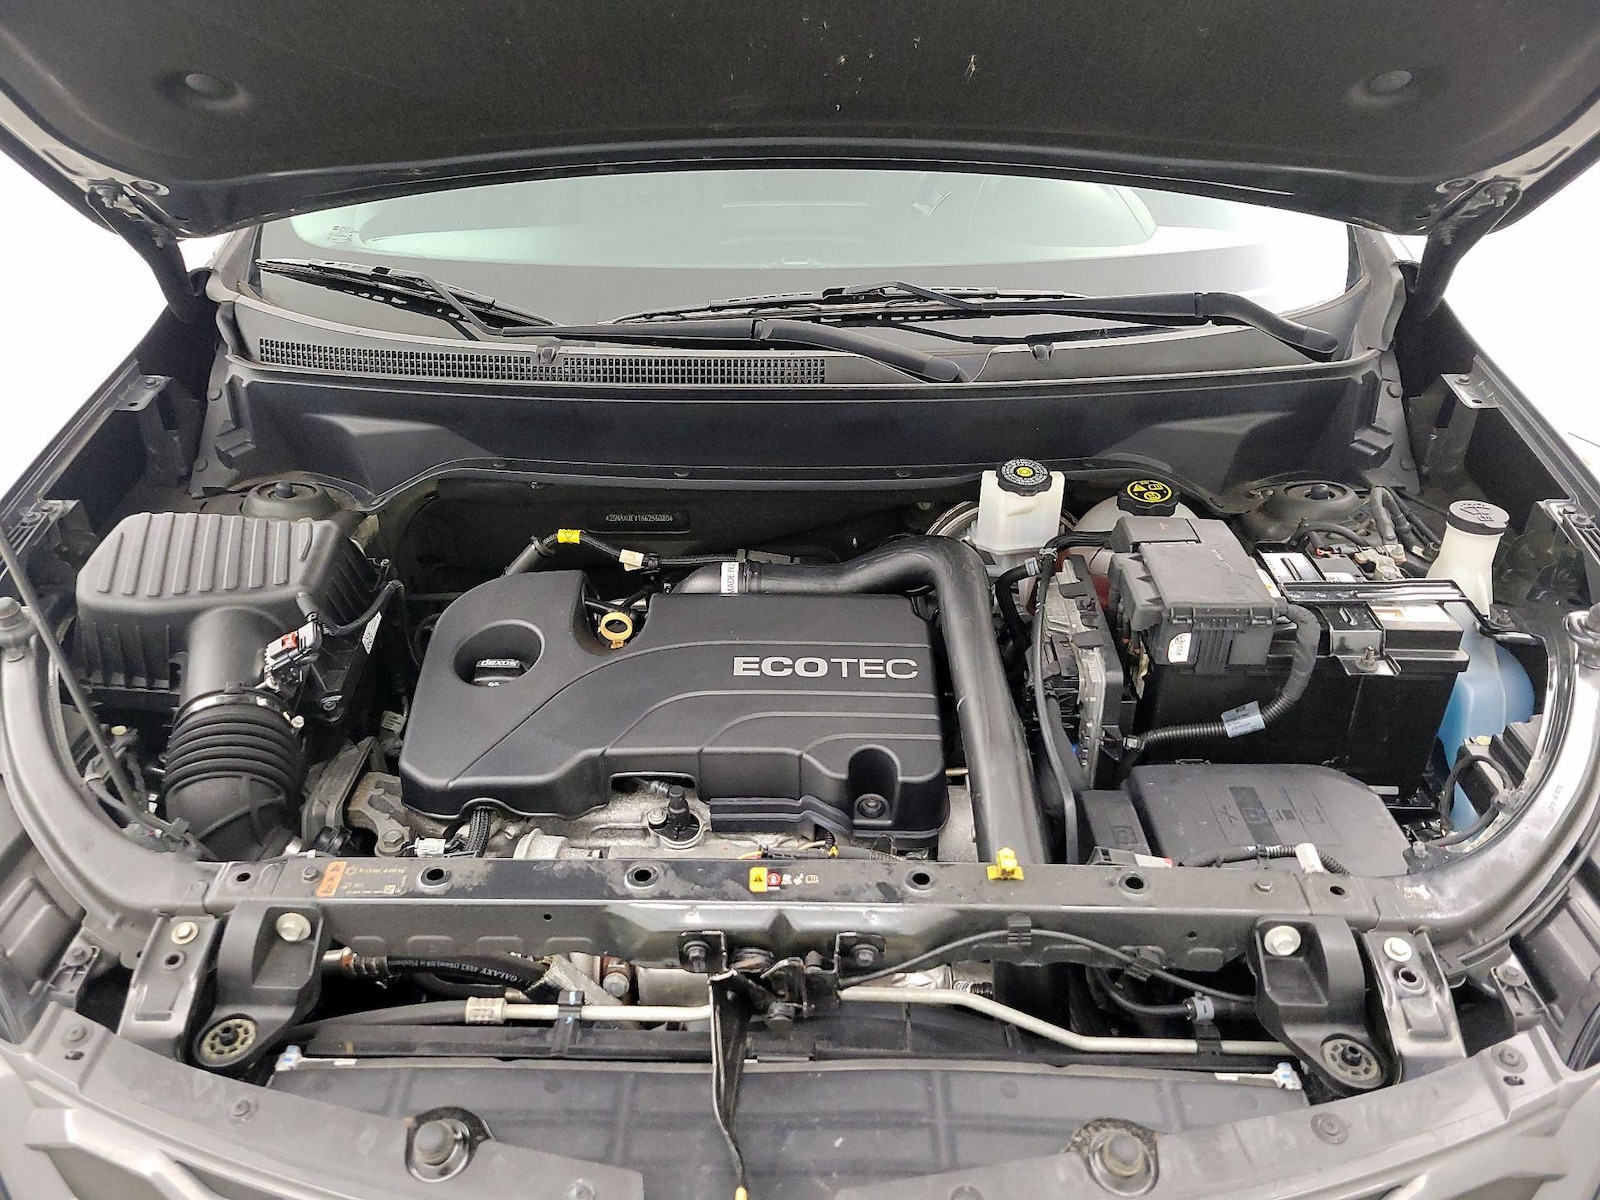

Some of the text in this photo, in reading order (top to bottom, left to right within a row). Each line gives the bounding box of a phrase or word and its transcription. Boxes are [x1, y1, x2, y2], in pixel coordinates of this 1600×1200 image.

[480, 659, 519, 667] dexos
[733, 656, 919, 679] ECOTEC
[479, 967, 519, 982] GALAXY
